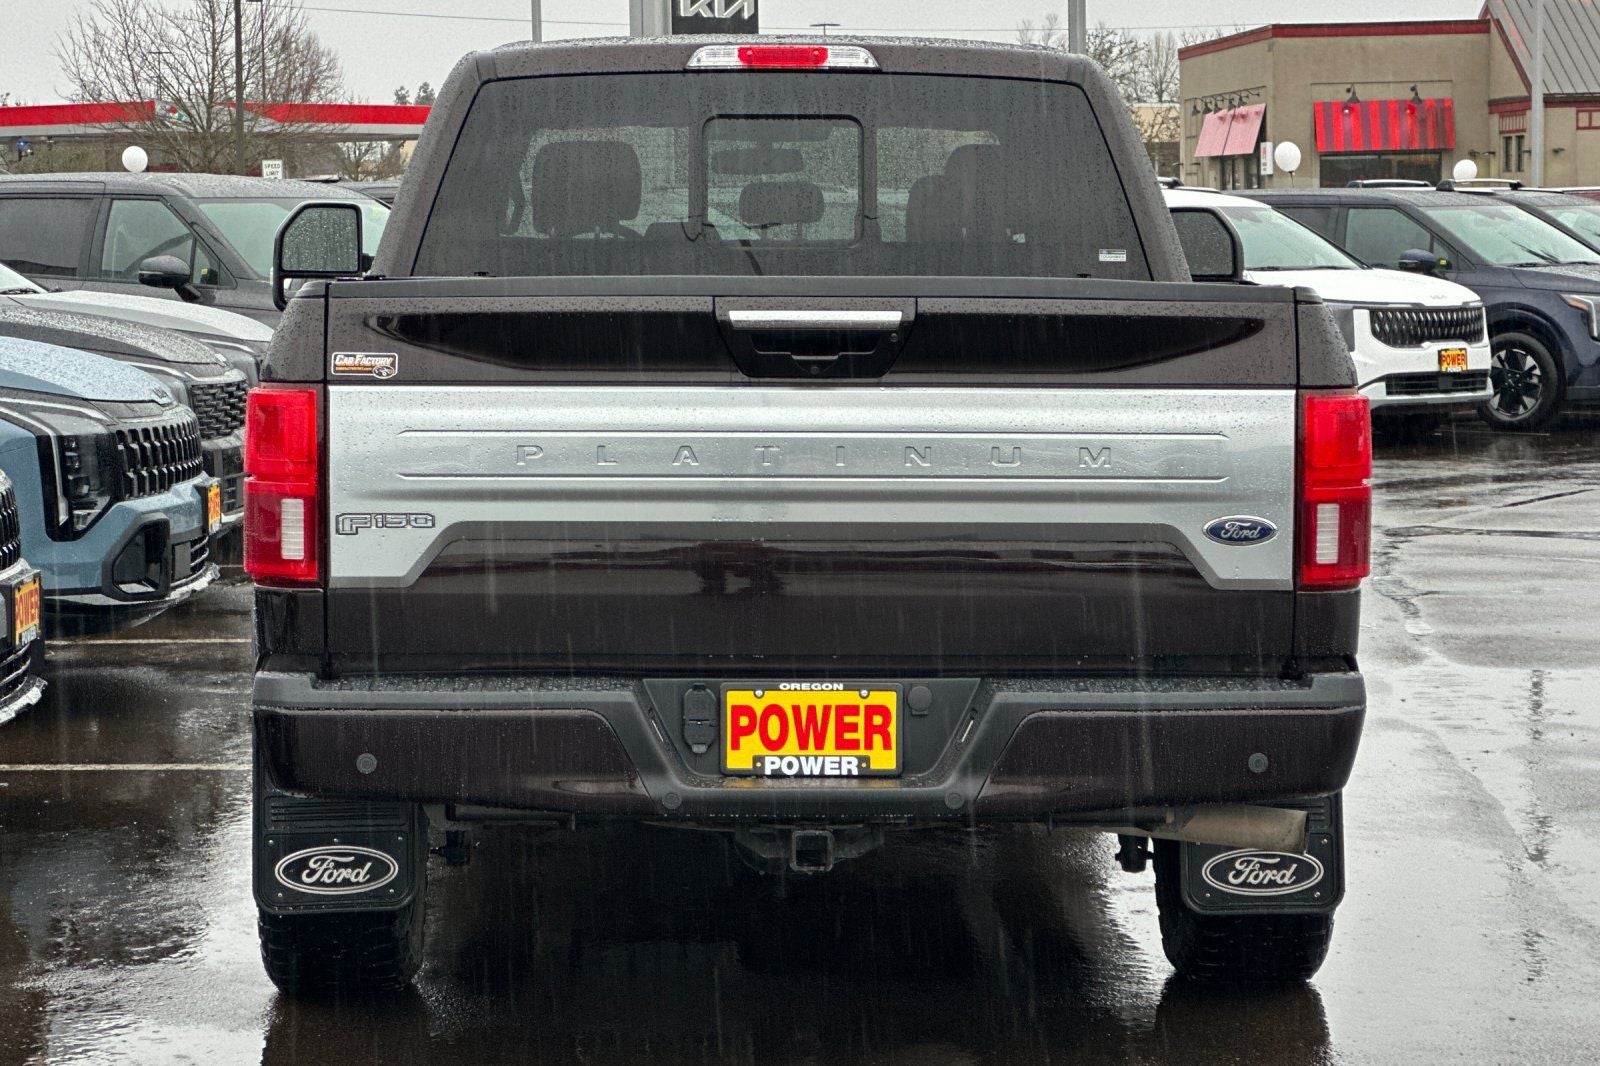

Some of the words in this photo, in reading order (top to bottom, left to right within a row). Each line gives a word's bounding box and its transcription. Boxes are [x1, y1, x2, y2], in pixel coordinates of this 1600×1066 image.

[1441, 353, 1466, 366] POWER
[516, 445, 1111, 467] PLATINUM
[1220, 521, 1261, 539] Ford
[778, 682, 844, 691] OREGON
[730, 703, 893, 752] POWER
[764, 756, 859, 776] POWER
[301, 855, 372, 883] Ford
[1228, 857, 1298, 885] Ford
